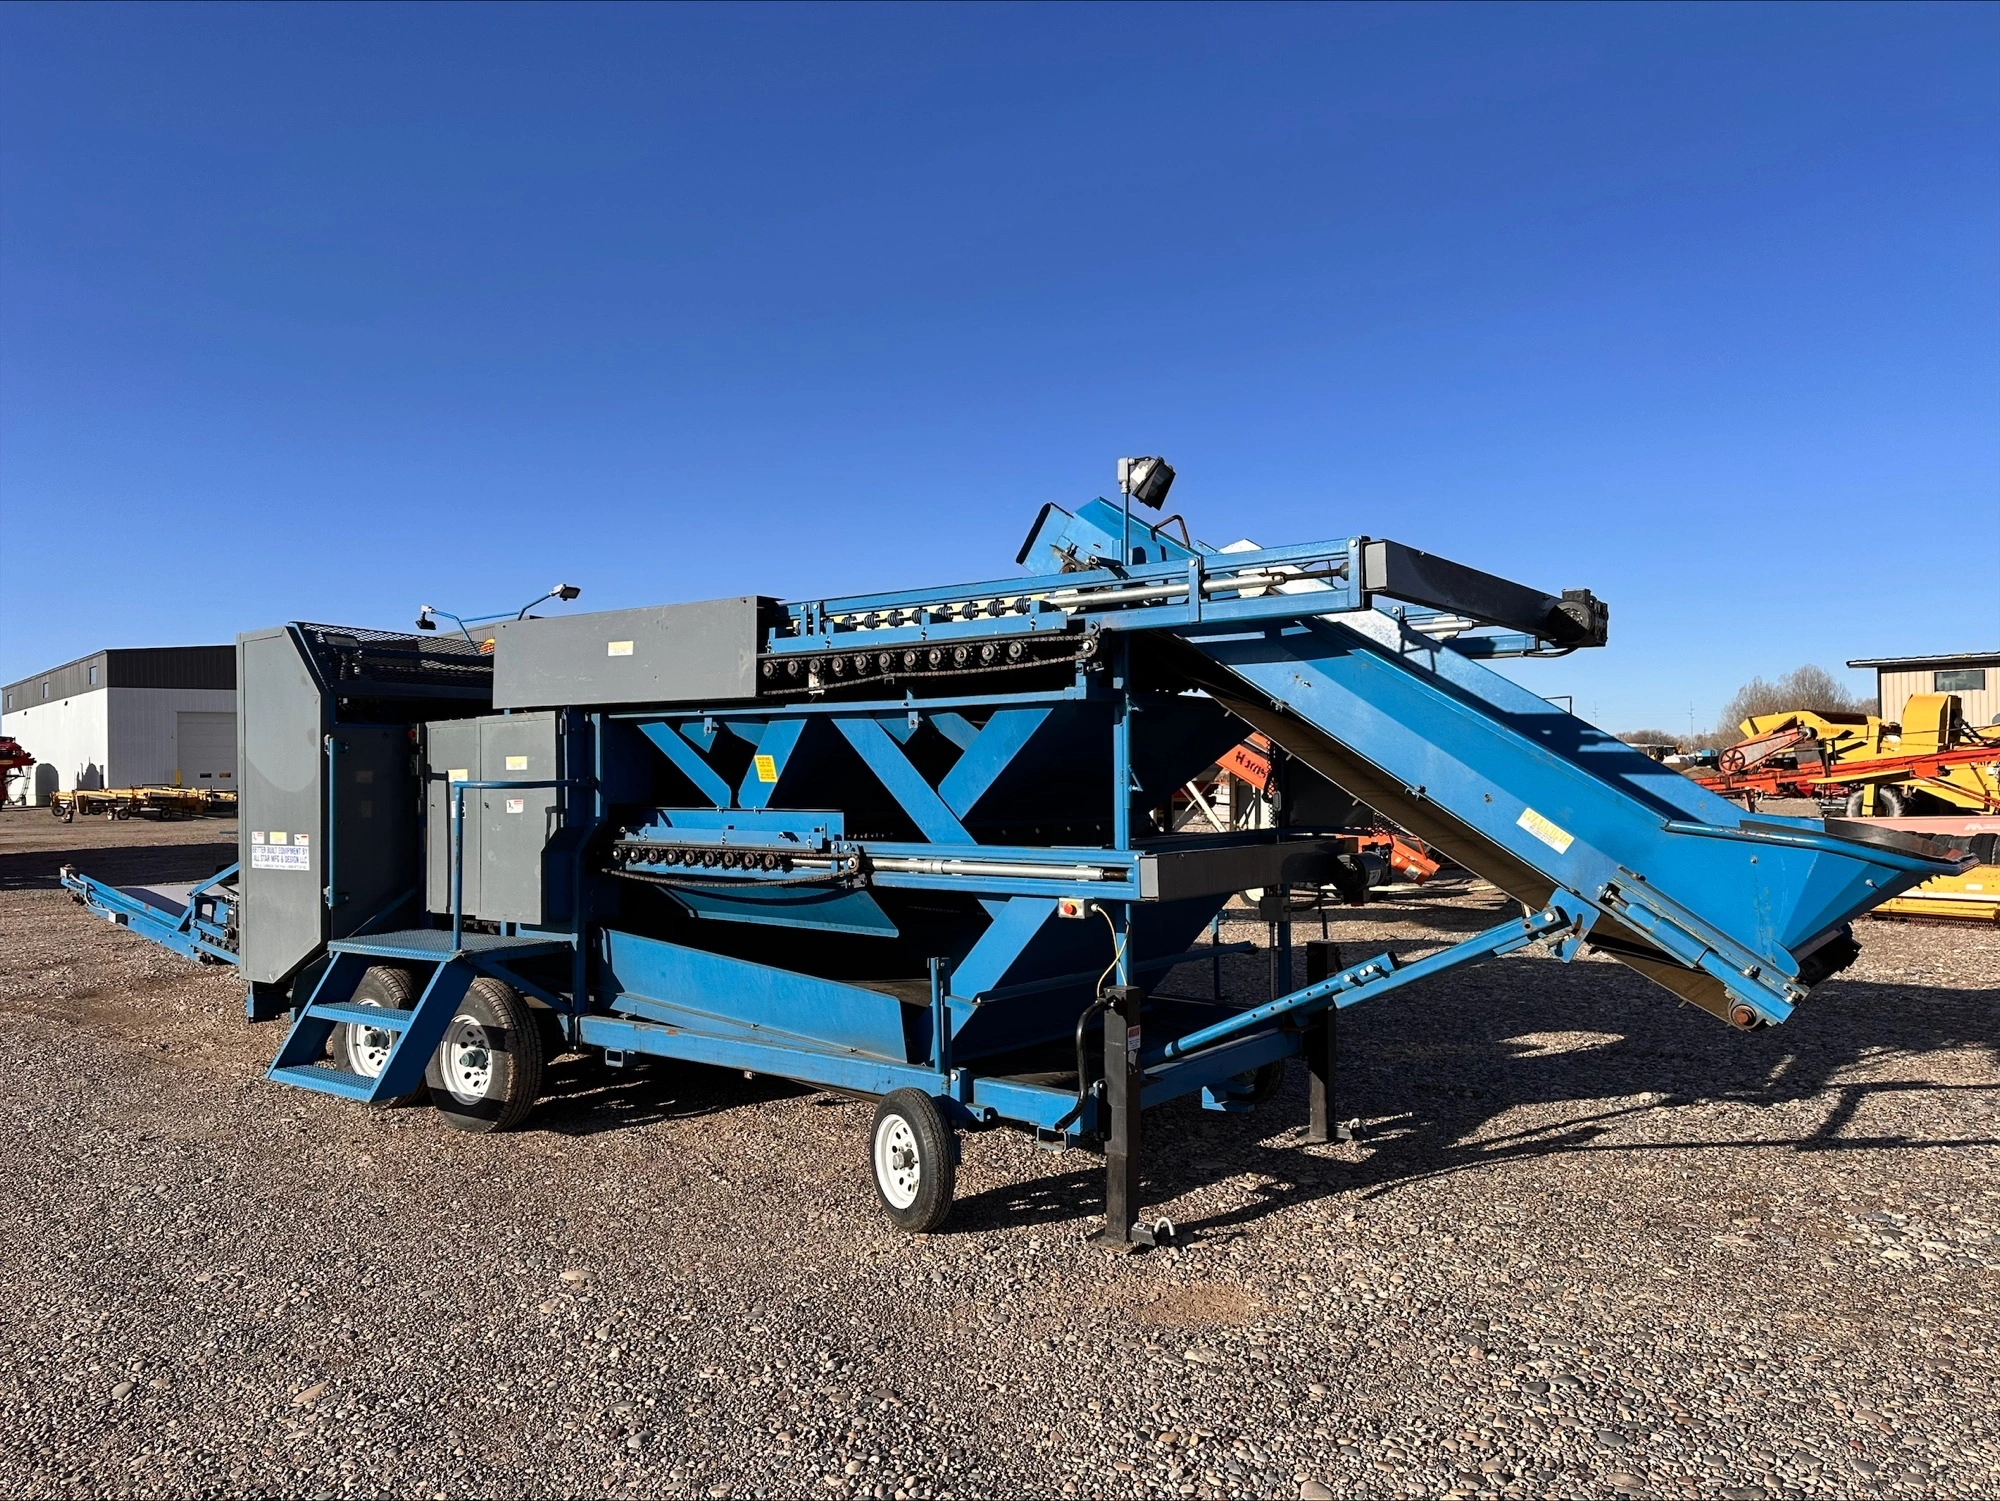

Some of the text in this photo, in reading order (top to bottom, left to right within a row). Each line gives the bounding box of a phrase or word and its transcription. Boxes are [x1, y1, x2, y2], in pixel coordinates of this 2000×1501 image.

[267, 846, 277, 854] BUILT
[278, 847, 301, 855] EQUIPMENT
[271, 855, 280, 863] MFG
